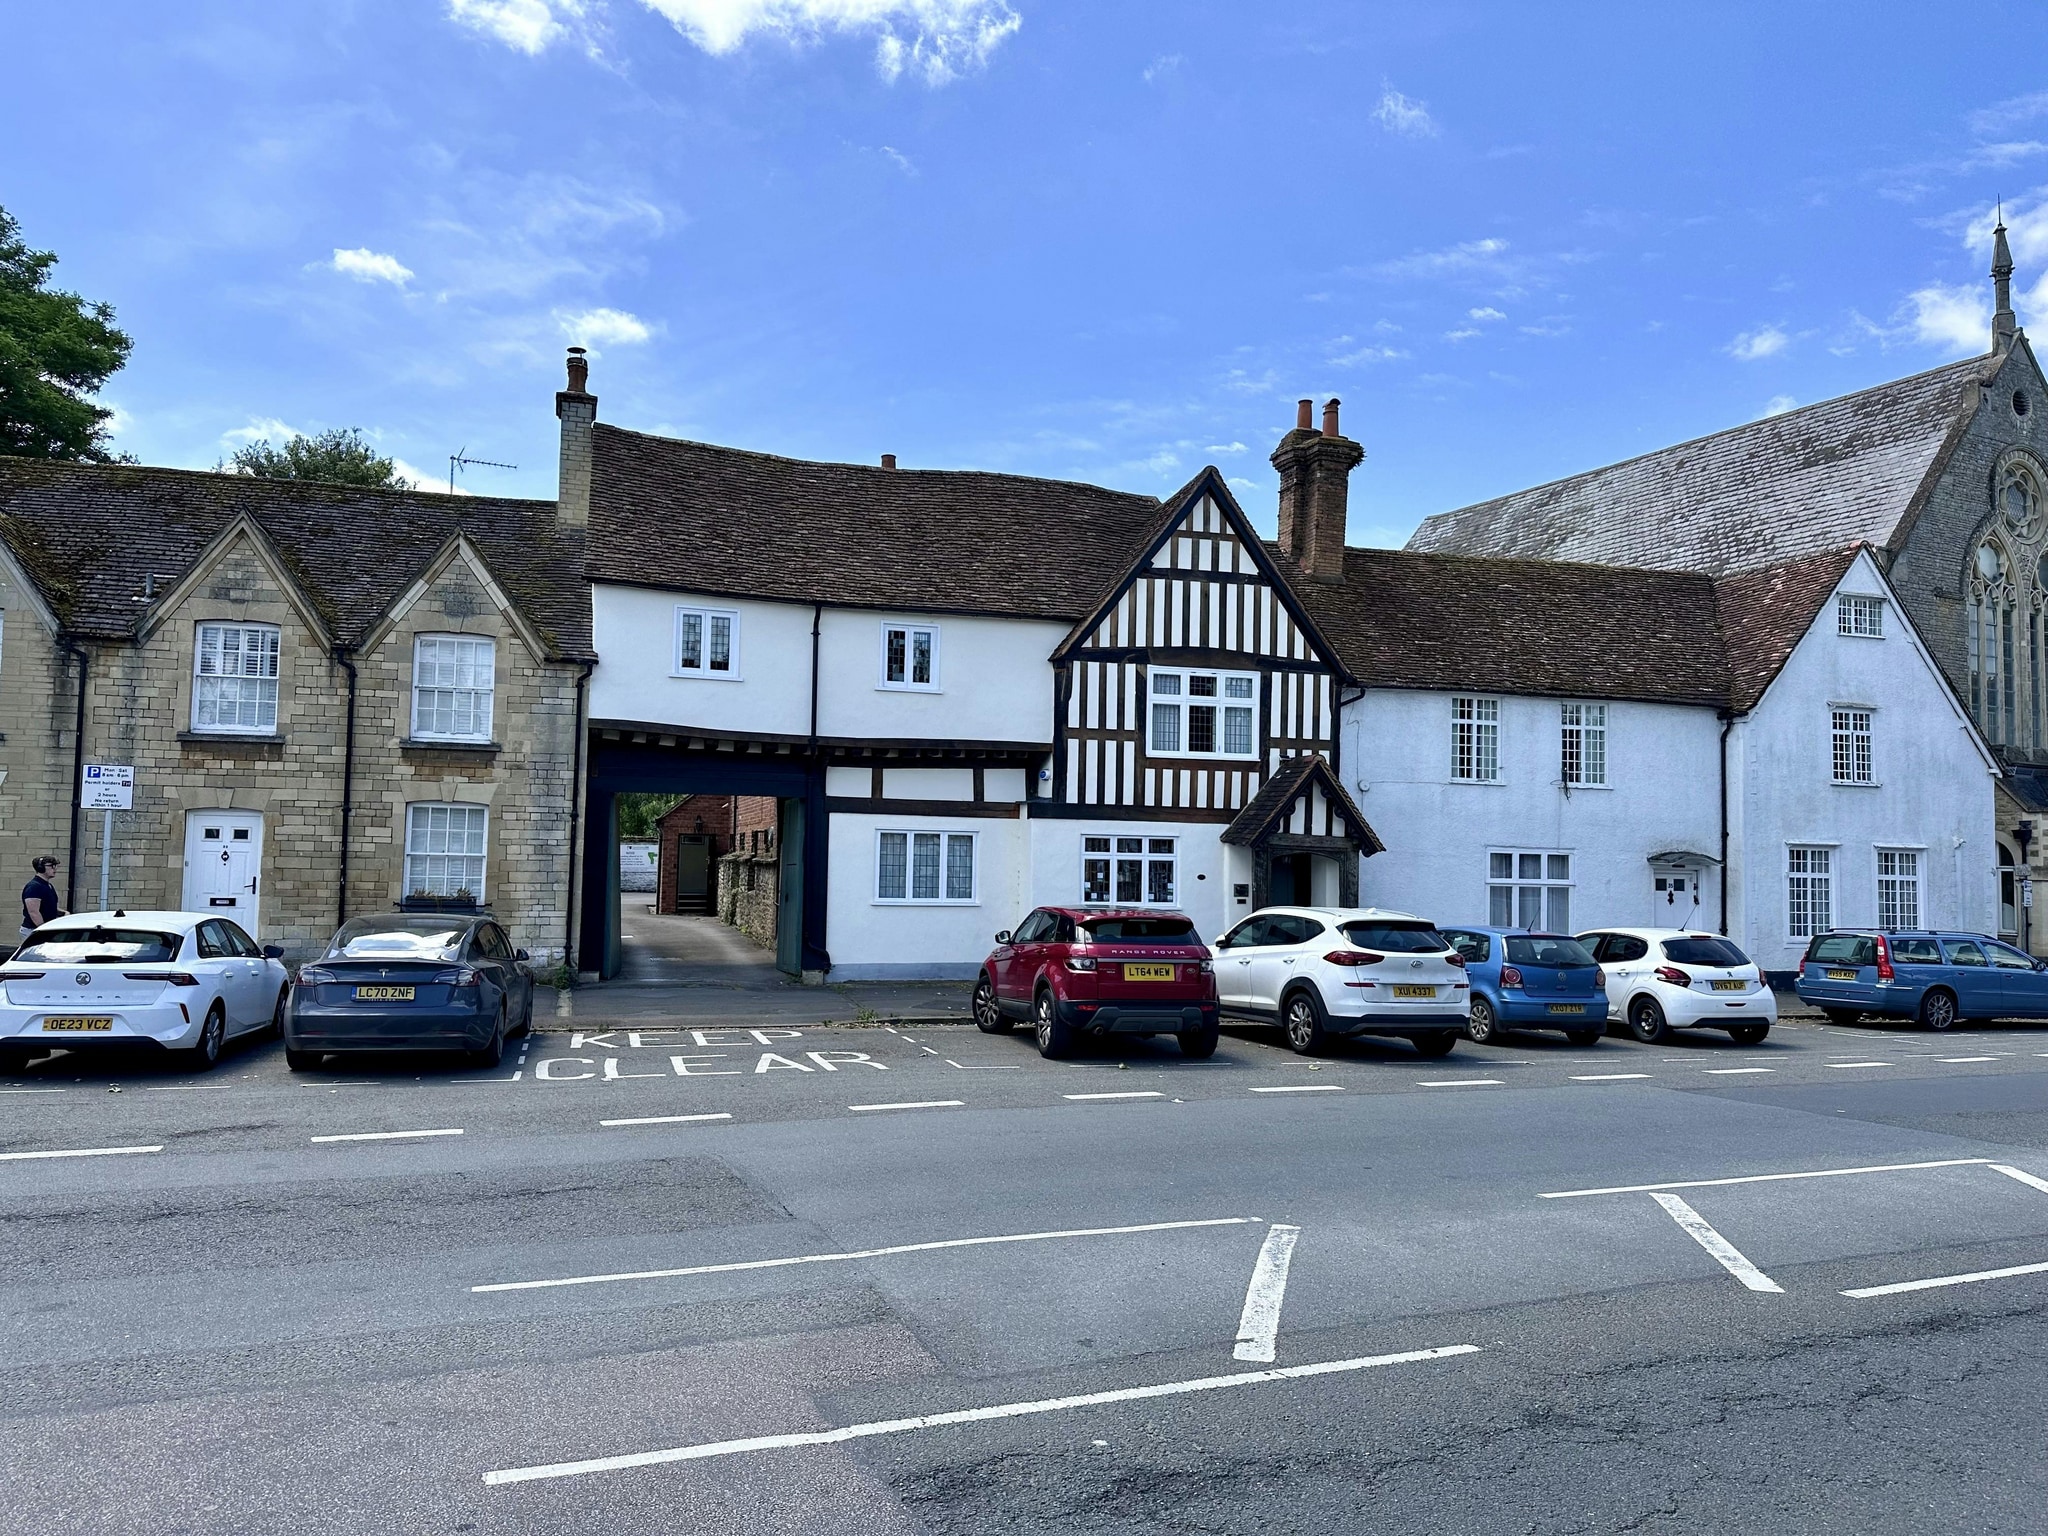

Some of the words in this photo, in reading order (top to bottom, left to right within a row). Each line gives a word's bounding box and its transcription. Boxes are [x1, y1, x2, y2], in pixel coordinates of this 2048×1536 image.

[91, 768, 99, 777] P
[1129, 968, 1151, 976] LT64
[1154, 968, 1170, 976] WEW
[358, 988, 388, 998] LC70
[391, 988, 412, 998] ZNF
[1412, 986, 1430, 996] 4337
[50, 1020, 83, 1030] OE23
[87, 1020, 110, 1030] VCZ
[570, 1030, 803, 1049] KEEP
[535, 1051, 890, 1081] CLEAR
